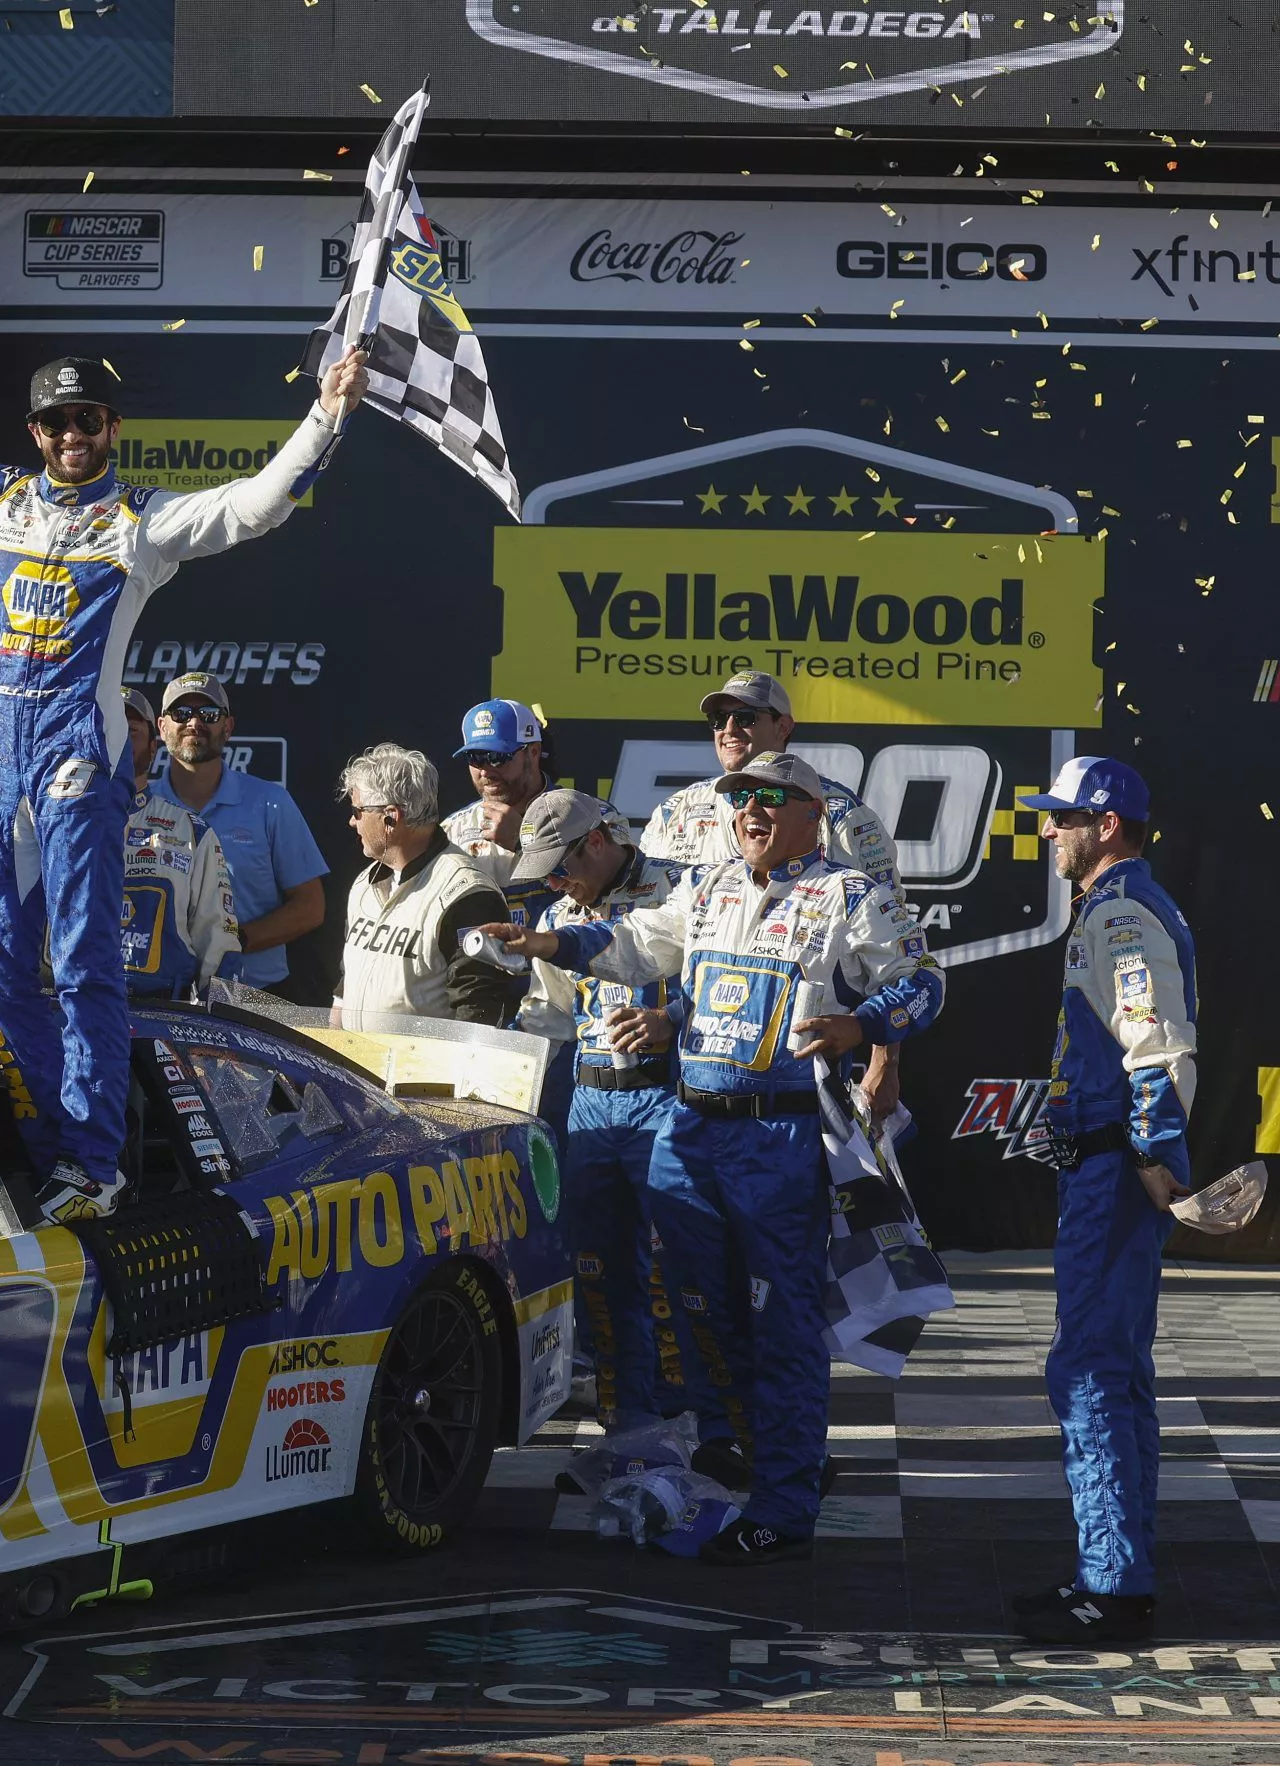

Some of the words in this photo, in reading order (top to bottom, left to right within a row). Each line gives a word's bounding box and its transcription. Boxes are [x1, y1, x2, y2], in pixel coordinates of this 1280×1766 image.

[653, 8, 983, 39] TALLADEGA
[68, 217, 143, 235] NASCAR
[43, 244, 81, 262] CUP
[82, 243, 144, 261] SERIES
[570, 229, 746, 285] Coca-Cola
[836, 240, 1048, 282] GEICO
[1129, 235, 1280, 297] xfinit
[78, 273, 142, 287] PLAYOFFS
[11, 577, 68, 617] NAPA
[558, 571, 1025, 646] YellaWood
[123, 640, 326, 685] LAYOFFS
[575, 646, 753, 678] Pressure
[765, 648, 920, 680] Treated
[936, 652, 1022, 682] Pine
[46, 758, 98, 799] 9
[1090, 789, 1111, 805] 9
[750, 945, 783, 958] ASHOC
[716, 985, 746, 1003] NAPA
[175, 1099, 203, 1110] HOOTERS
[190, 1129, 214, 1138] TOOLS
[196, 1143, 221, 1152] SIEMENS
[261, 1171, 405, 1285] AUTO
[408, 1149, 528, 1257] PARTS
[578, 1257, 598, 1274] NAPA
[456, 1267, 497, 1337] EAGLE
[268, 1340, 340, 1375] ASHOC
[267, 1379, 346, 1413] HOOTERS
[265, 1446, 332, 1483] LLumar
[93, 1673, 835, 1710] VICTORY
[893, 1691, 1280, 1716] LAN
